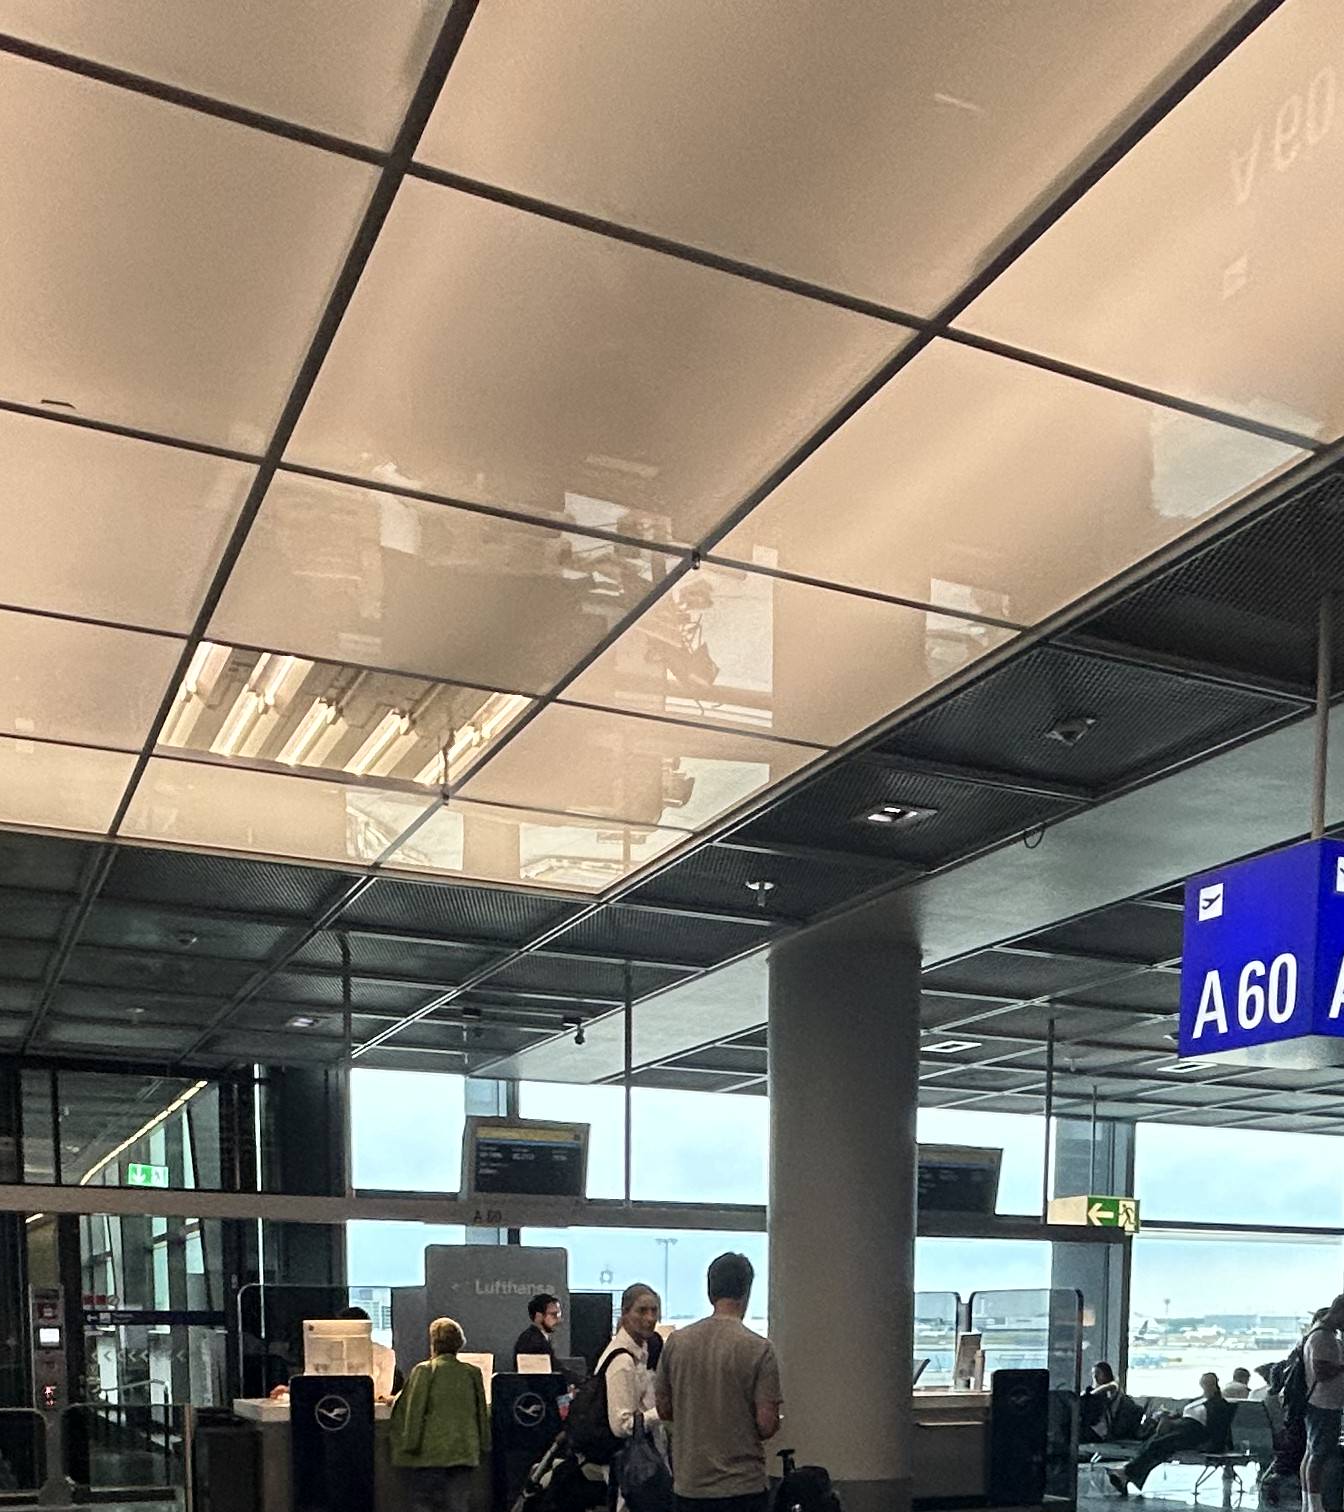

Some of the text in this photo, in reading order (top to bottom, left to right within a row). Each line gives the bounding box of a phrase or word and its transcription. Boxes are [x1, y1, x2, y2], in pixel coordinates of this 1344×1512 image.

[1191, 952, 1298, 1039] A 60
[475, 1279, 556, 1296] Lufthansa
